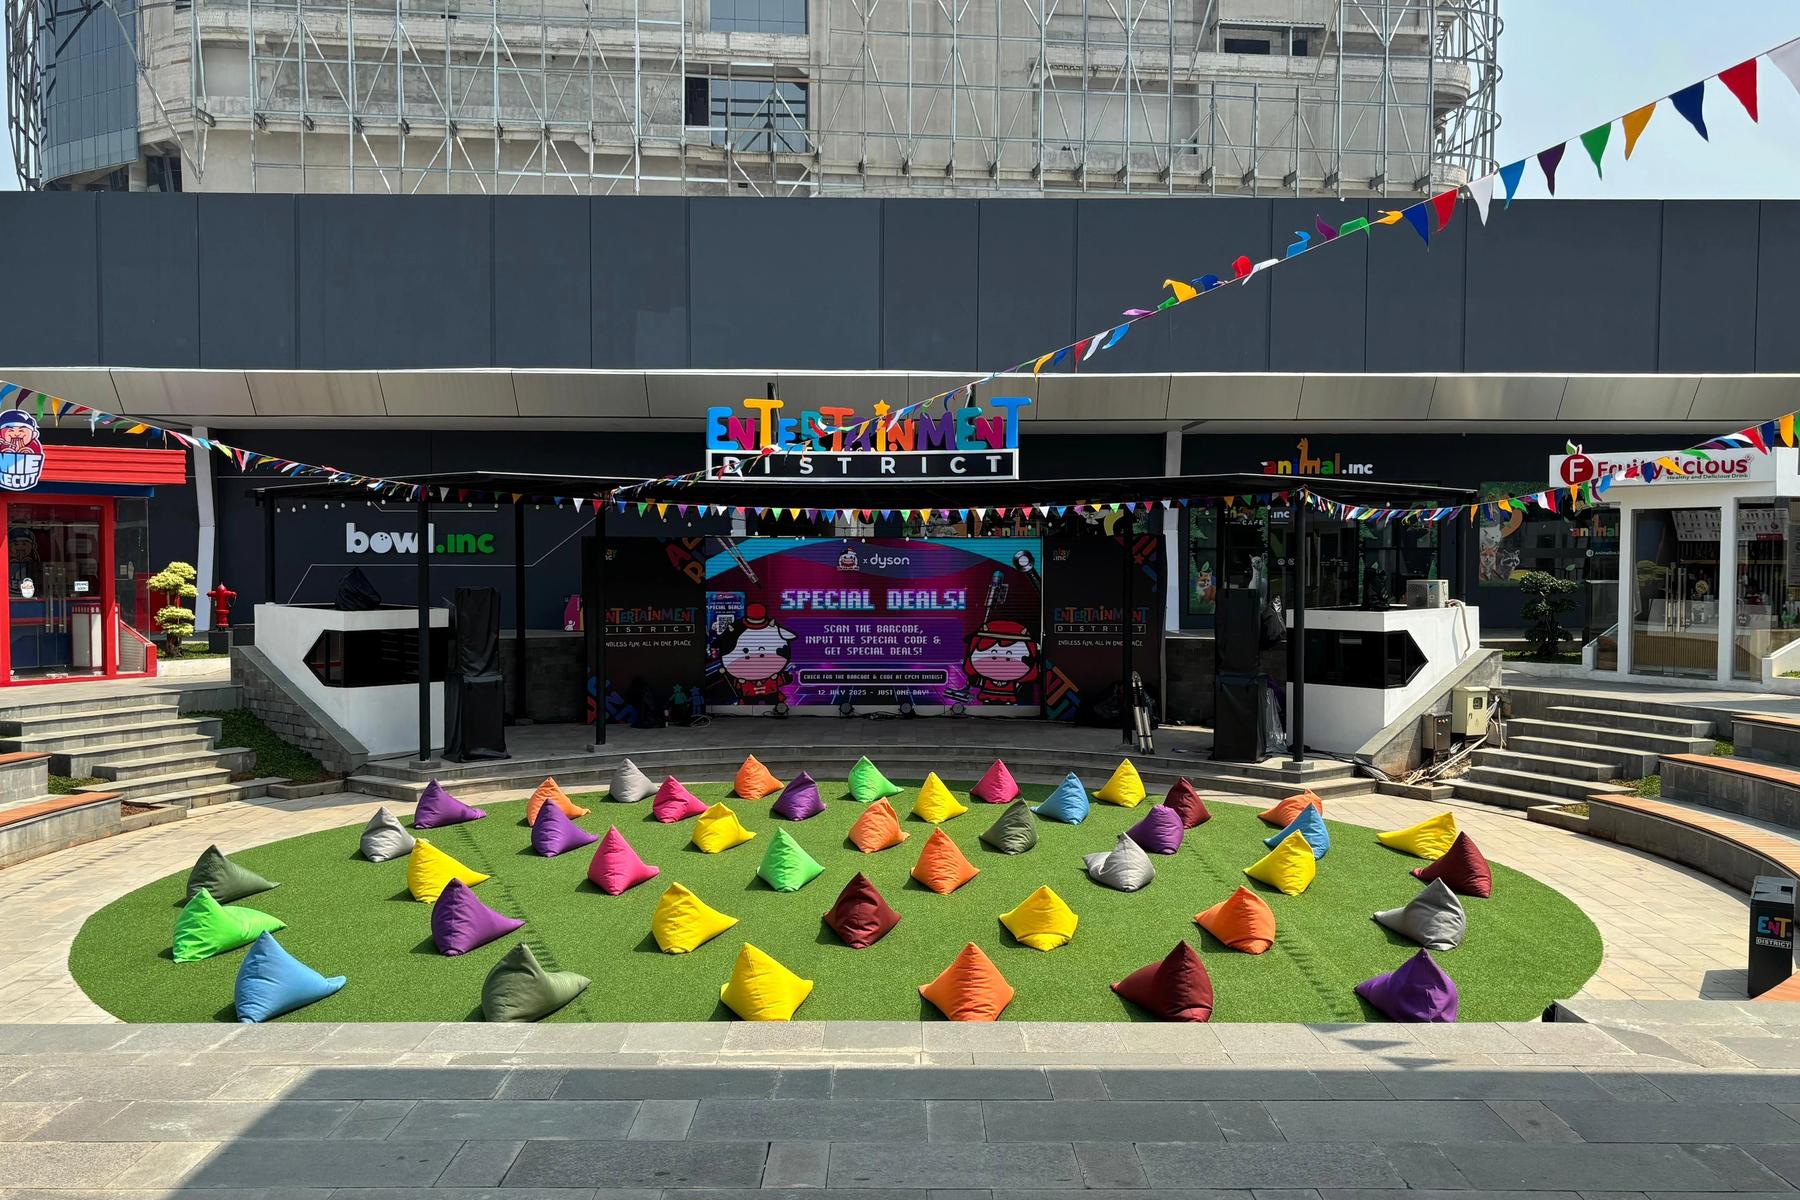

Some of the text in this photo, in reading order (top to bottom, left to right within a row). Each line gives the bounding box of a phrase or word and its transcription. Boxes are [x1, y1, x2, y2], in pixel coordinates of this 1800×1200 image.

[722, 455, 1002, 474] DISTRICT
[1261, 443, 1373, 475] animal.inc
[346, 522, 495, 554] bowl.inc
[870, 553, 910, 569] dyson
[780, 589, 967, 611] SPECIAL DEALS!
[824, 625, 924, 634] SCAN THE BARCODE,
[1057, 625, 1143, 633] DISTRIT
[805, 636, 942, 644] INPUT THE SPECIAL CODE &
[825, 647, 922, 655] GET SPECIAL DEALS!
[1757, 938, 1791, 948] DISTRICT
